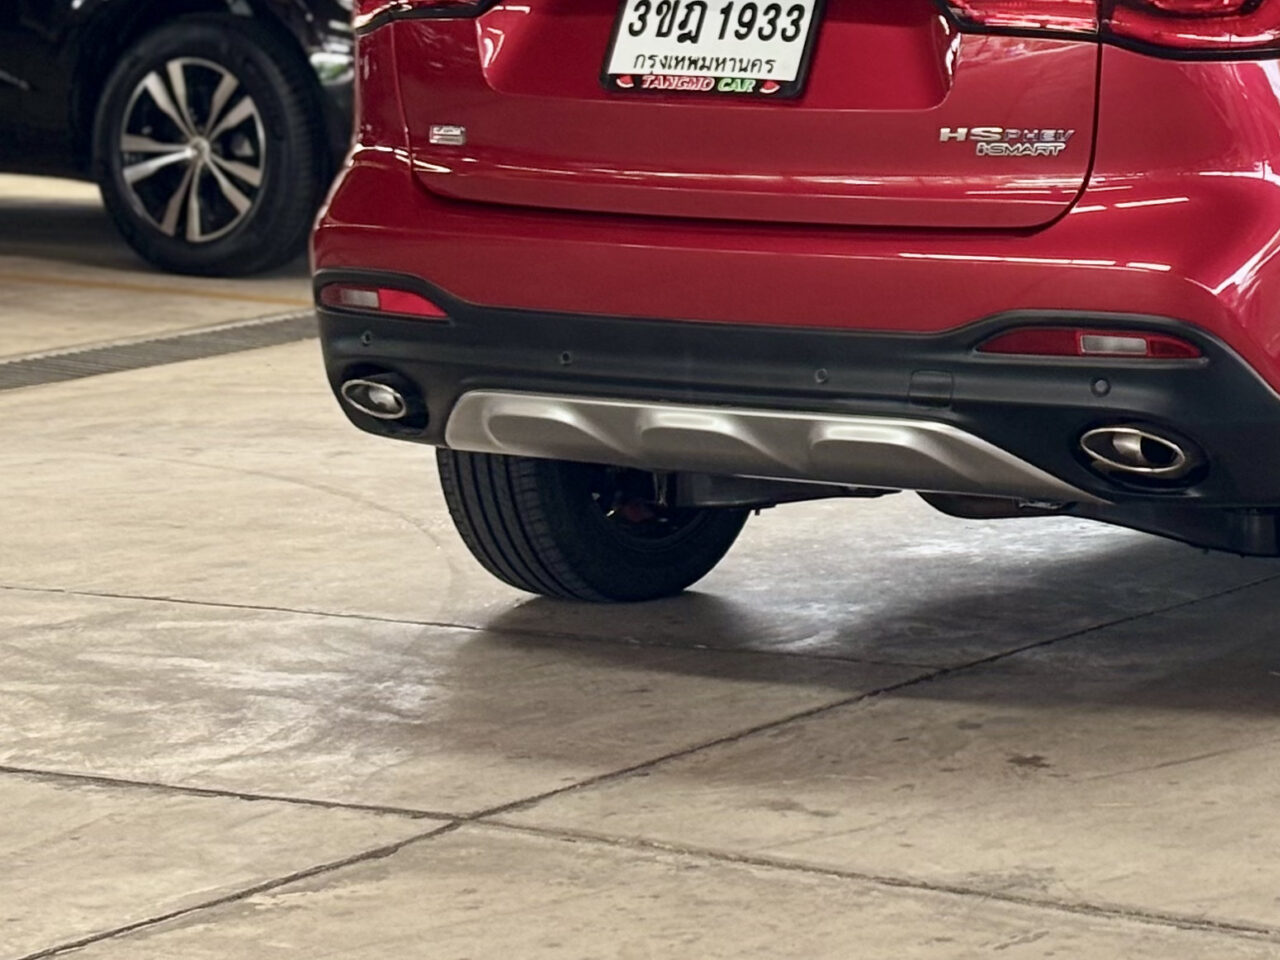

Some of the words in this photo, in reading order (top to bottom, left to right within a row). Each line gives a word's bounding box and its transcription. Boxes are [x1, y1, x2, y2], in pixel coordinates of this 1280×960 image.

[717, 0, 806, 43] 1933
[633, 53, 777, 76] กรุงเทพมหานคร
[641, 74, 716, 92] TANGMO
[717, 77, 756, 93] CAR
[939, 126, 1003, 142] HS
